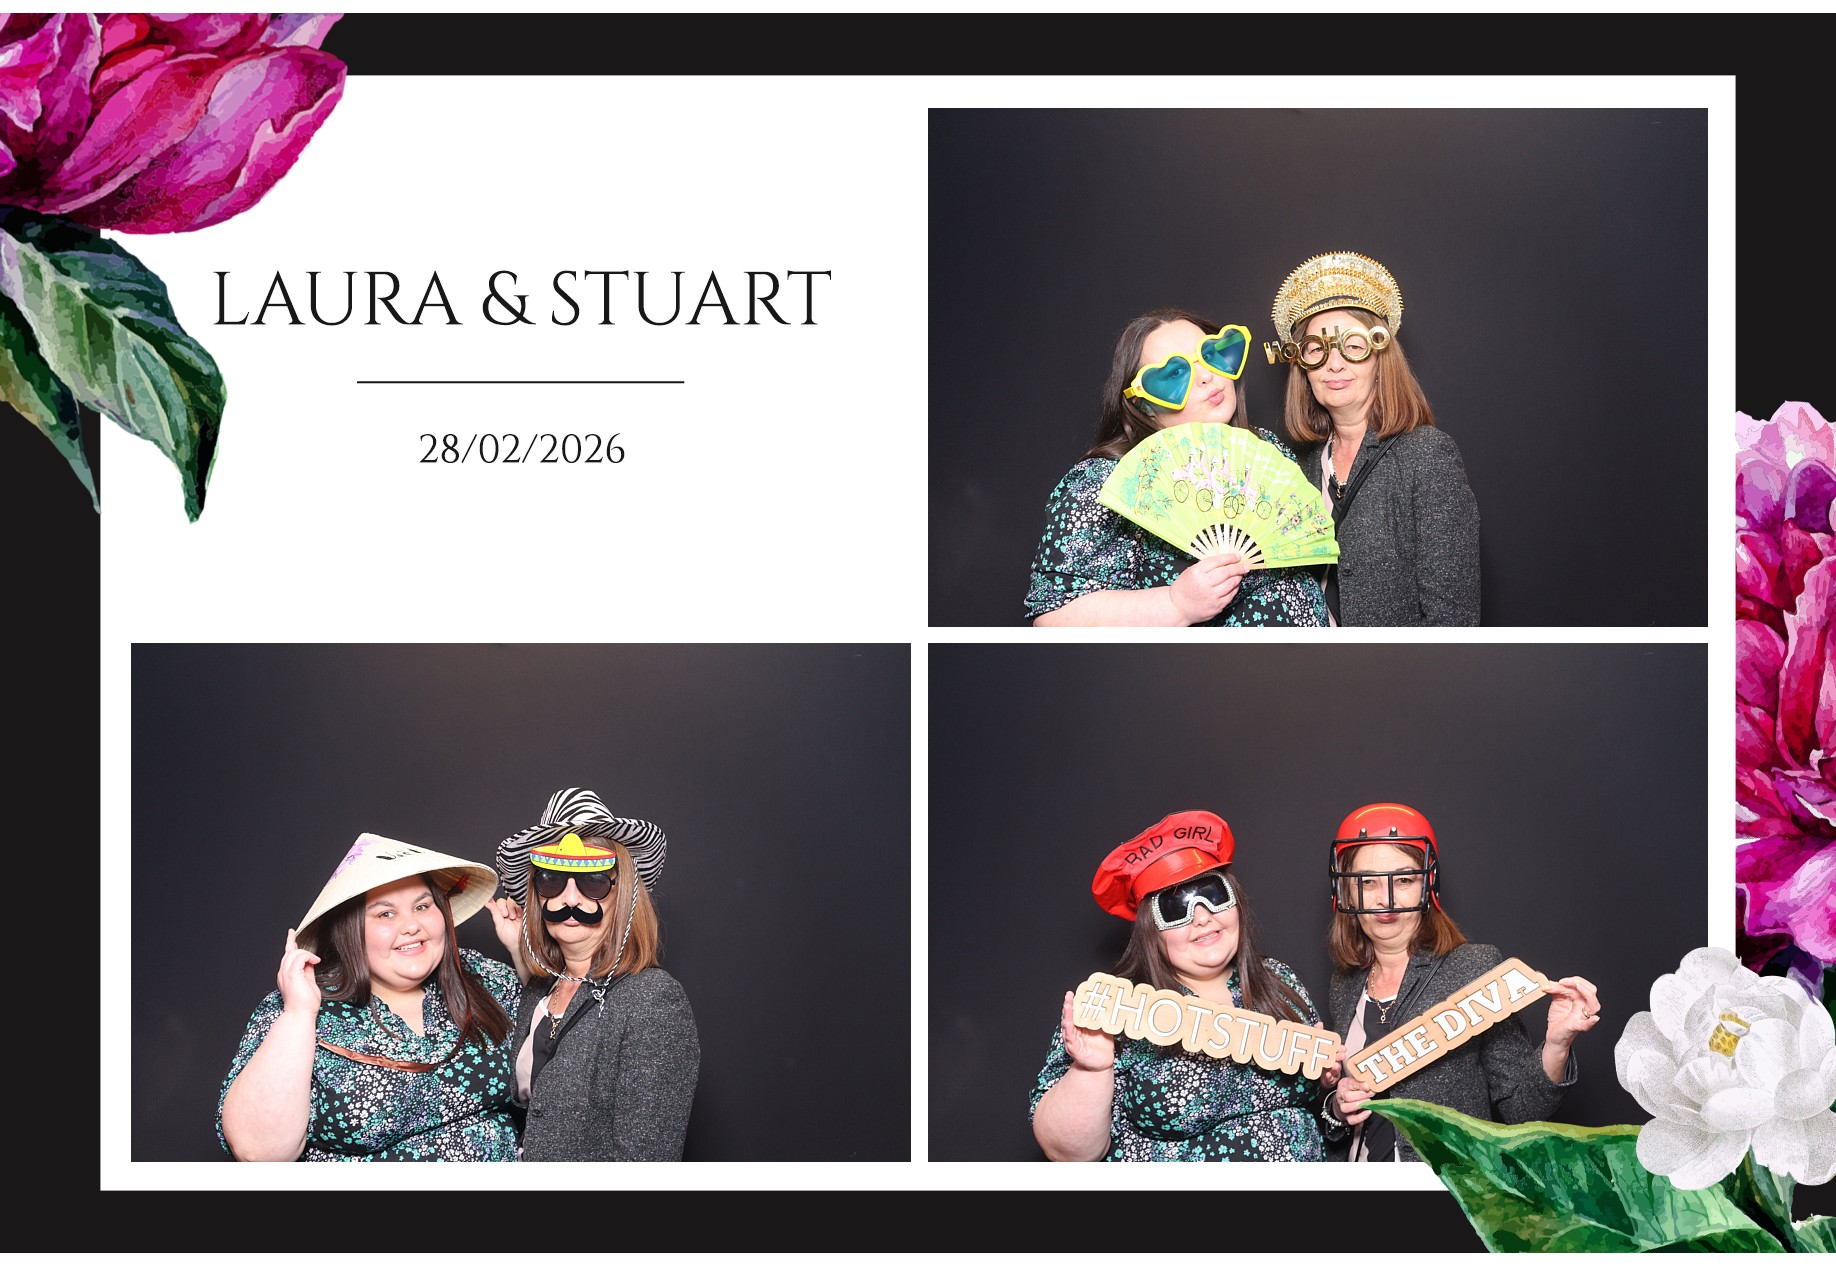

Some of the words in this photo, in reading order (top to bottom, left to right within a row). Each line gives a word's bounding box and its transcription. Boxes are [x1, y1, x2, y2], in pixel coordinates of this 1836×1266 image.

[1173, 826, 1214, 843] GIRL
[1081, 981, 1334, 1072] #HOTSTUFF
[1356, 1025, 1439, 1084] THE
[1432, 968, 1541, 1041] DIVA
